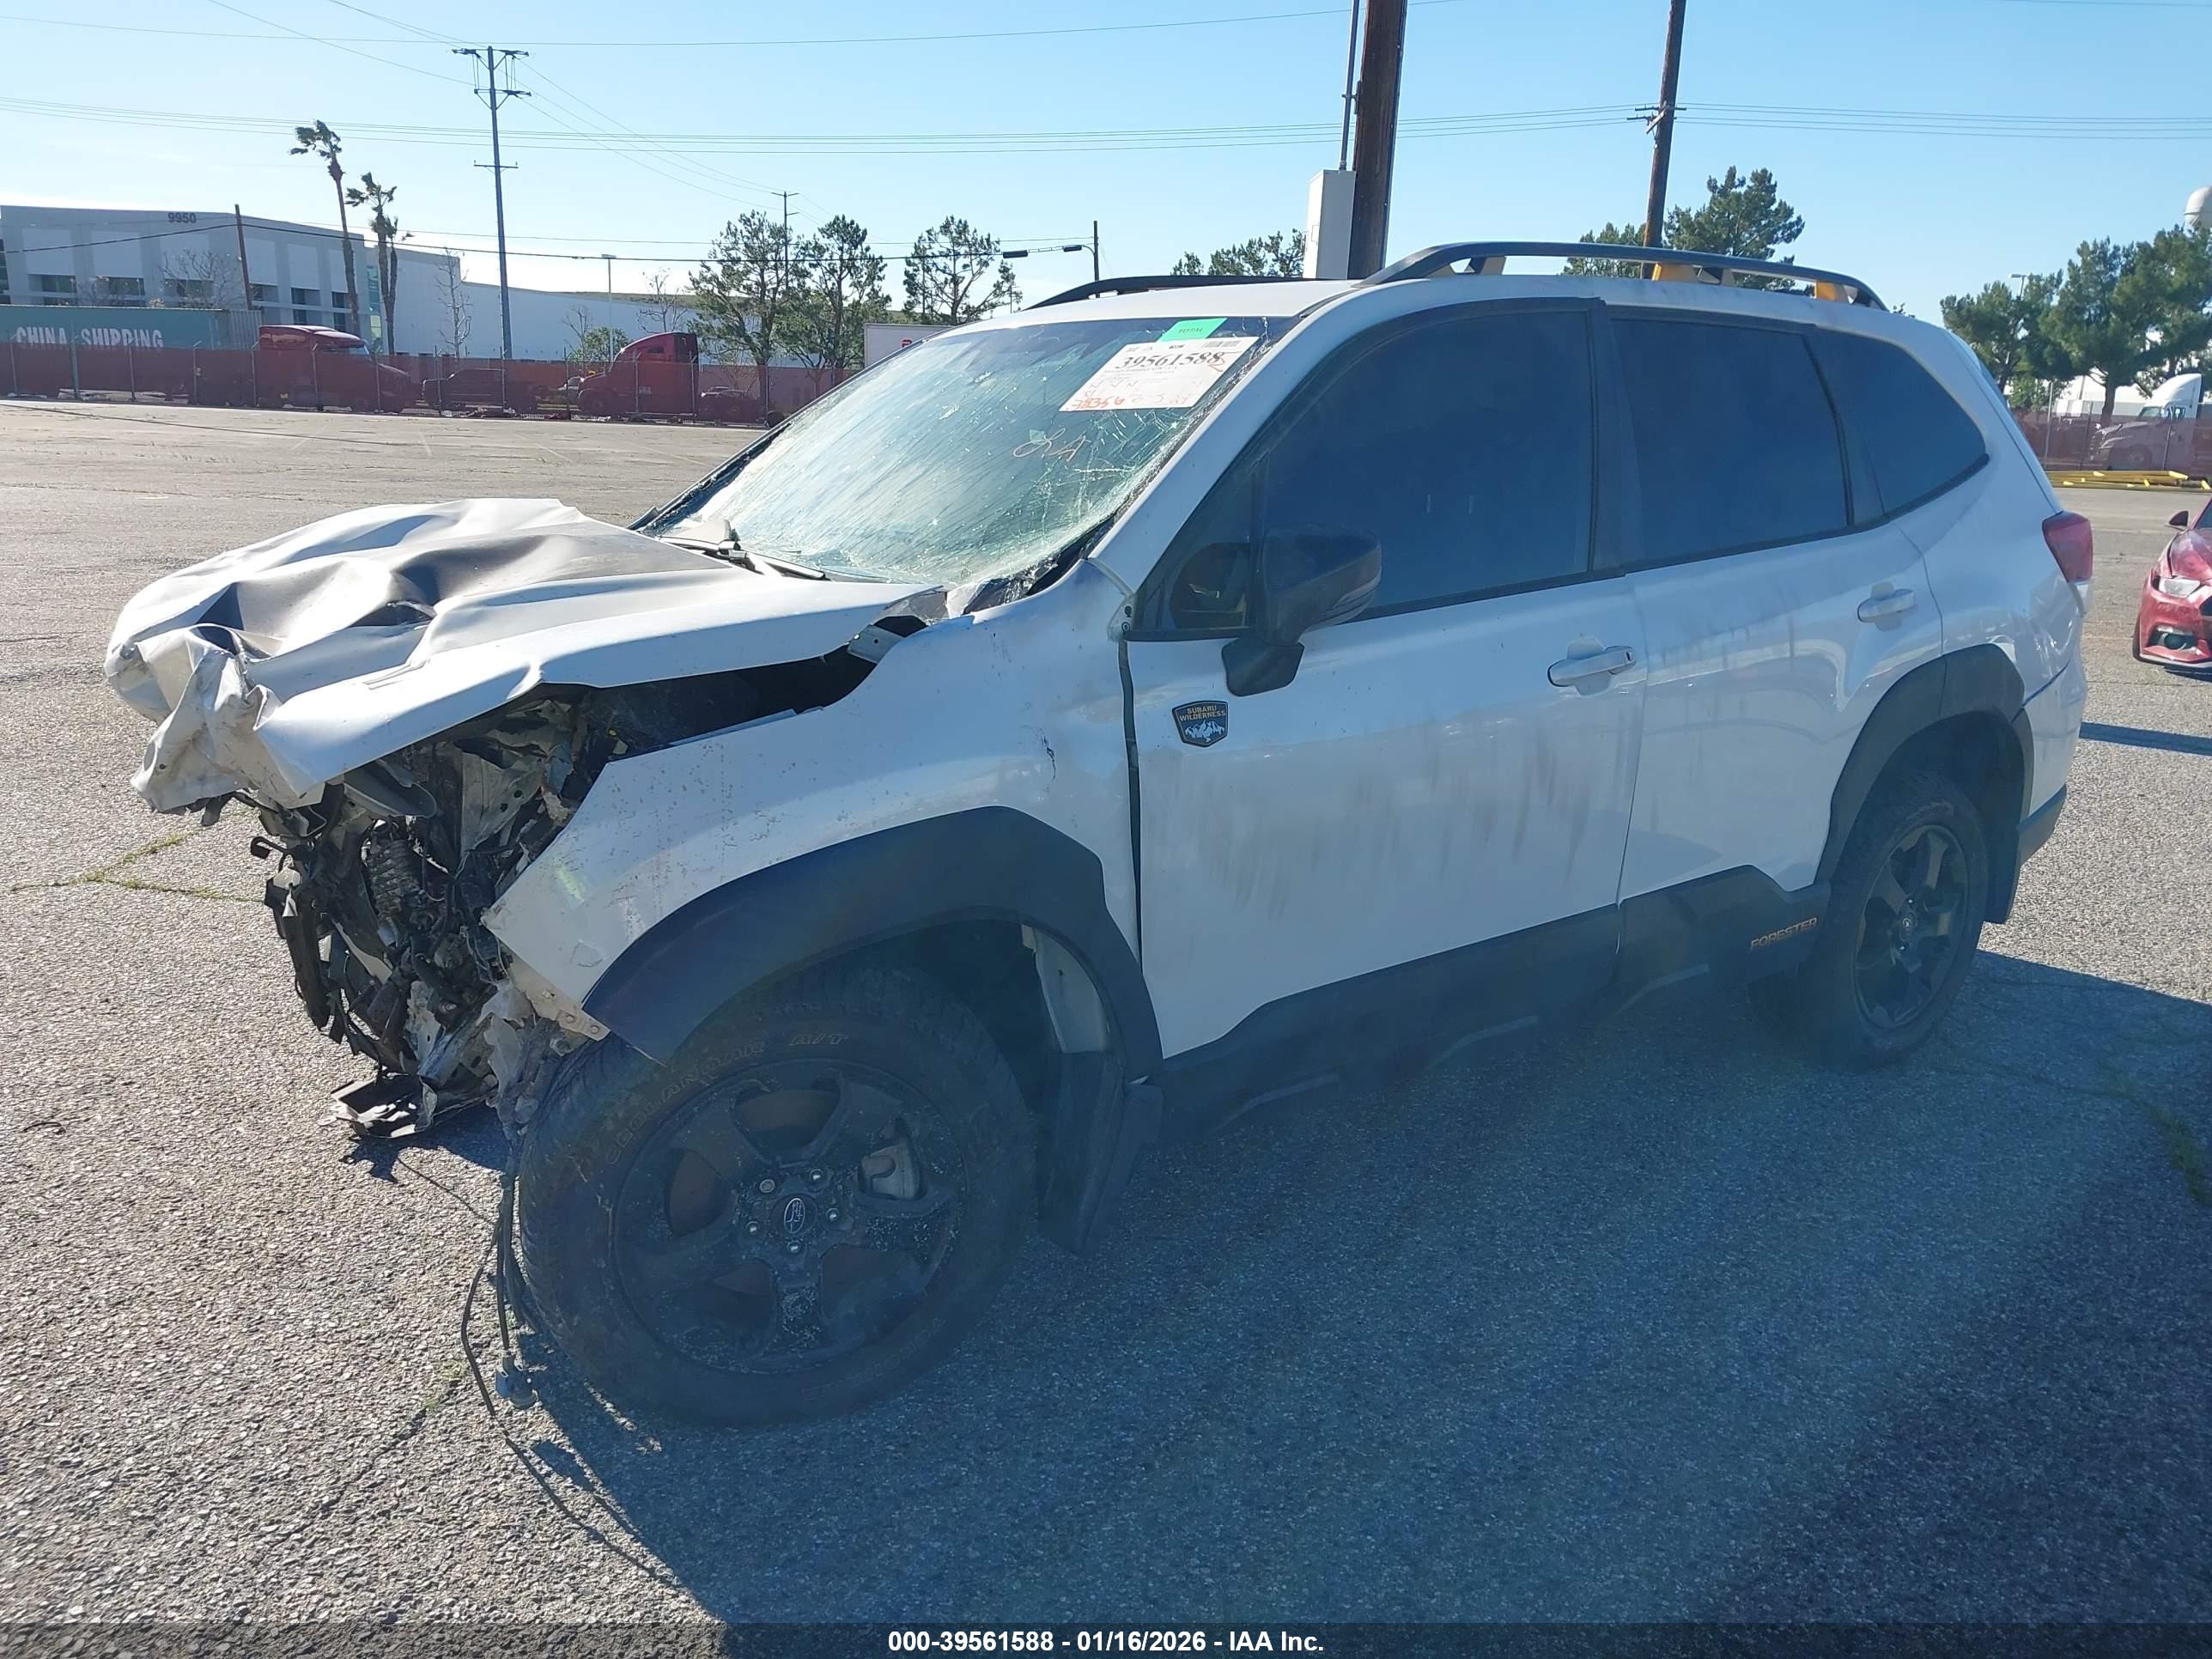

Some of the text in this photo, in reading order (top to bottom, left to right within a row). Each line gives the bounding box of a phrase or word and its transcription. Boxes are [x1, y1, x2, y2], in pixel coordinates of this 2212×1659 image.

[167, 212, 197, 223] 9950
[15, 326, 165, 348] CHINA SHIPPING
[1115, 351, 1225, 369] 39561588
[1179, 709, 1226, 721] WILDERNESS
[1187, 705, 1218, 714] SUBARU
[1750, 916, 1819, 949] FORESTER
